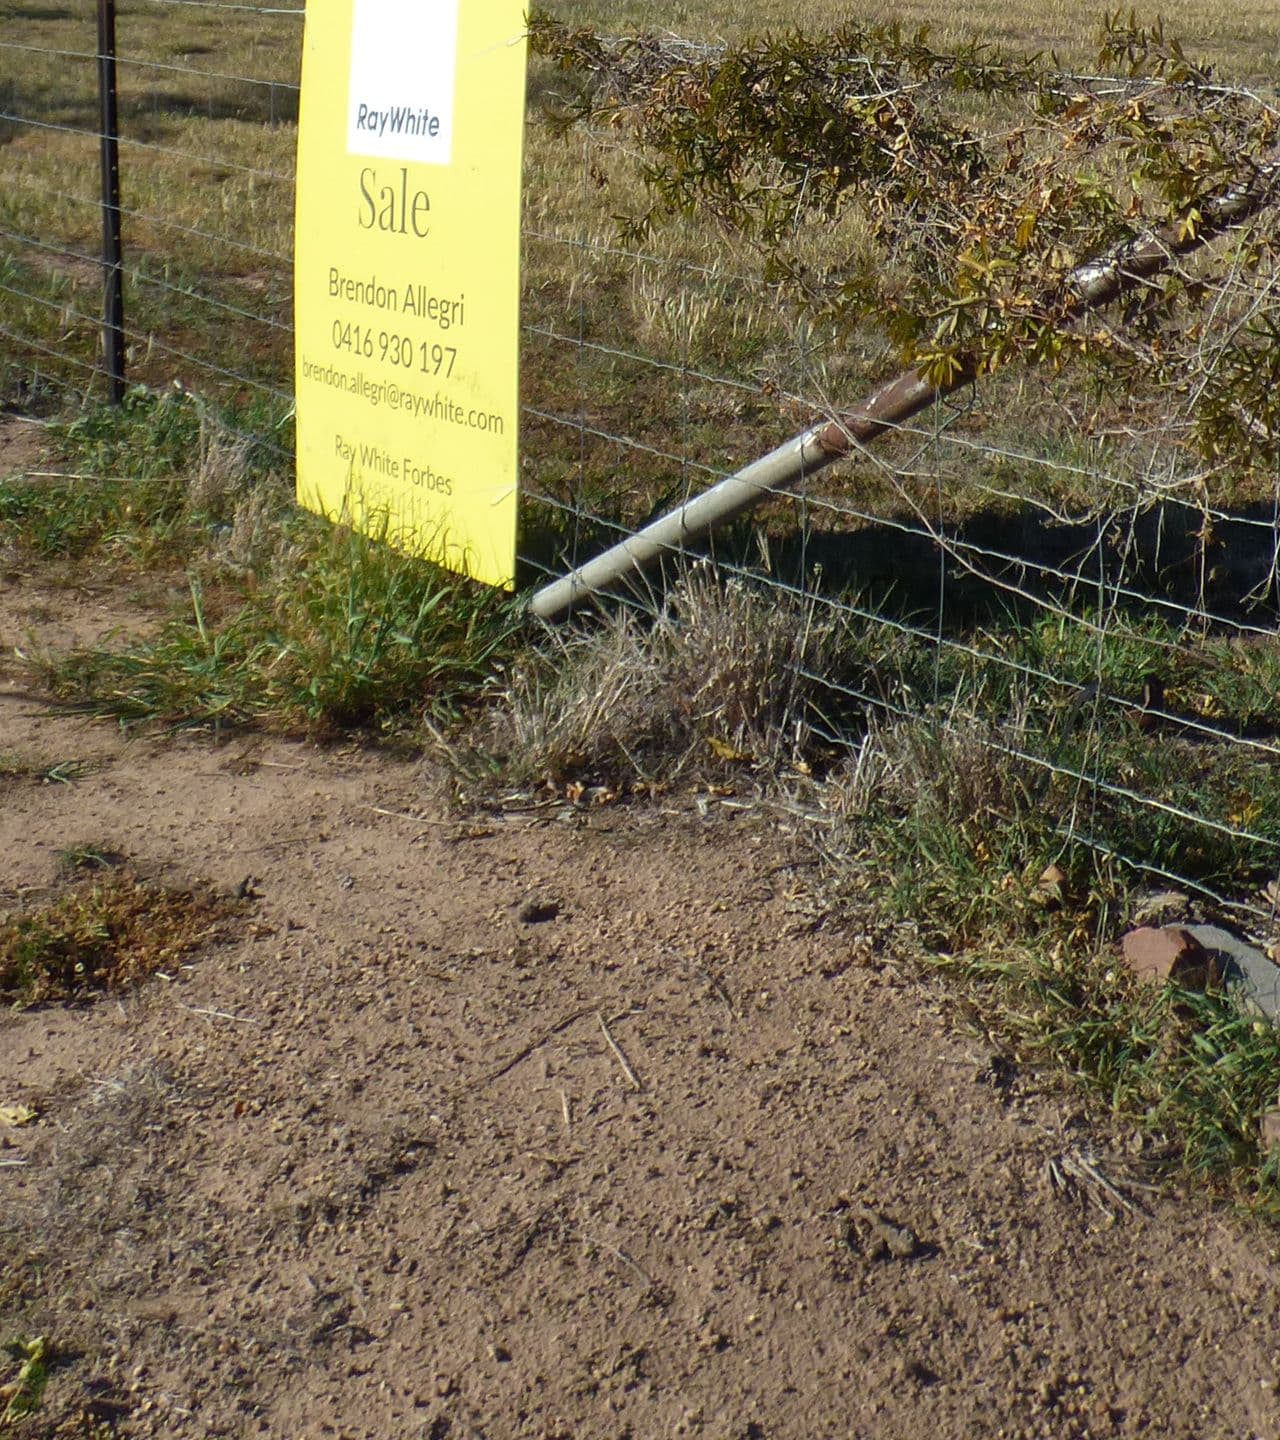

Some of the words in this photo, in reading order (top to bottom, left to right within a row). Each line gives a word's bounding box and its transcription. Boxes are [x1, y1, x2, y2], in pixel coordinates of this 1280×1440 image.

[358, 168, 430, 238] Sale
[329, 267, 397, 311] Brendon
[402, 284, 464, 329] Allegri
[332, 320, 373, 358] 0416
[379, 332, 413, 368] 930
[420, 342, 457, 379] 197
[302, 356, 504, 434] brendon.allegri@raywhite.com
[335, 435, 356, 460] Ray
[360, 444, 399, 478] White
[403, 459, 453, 496] Forbes
